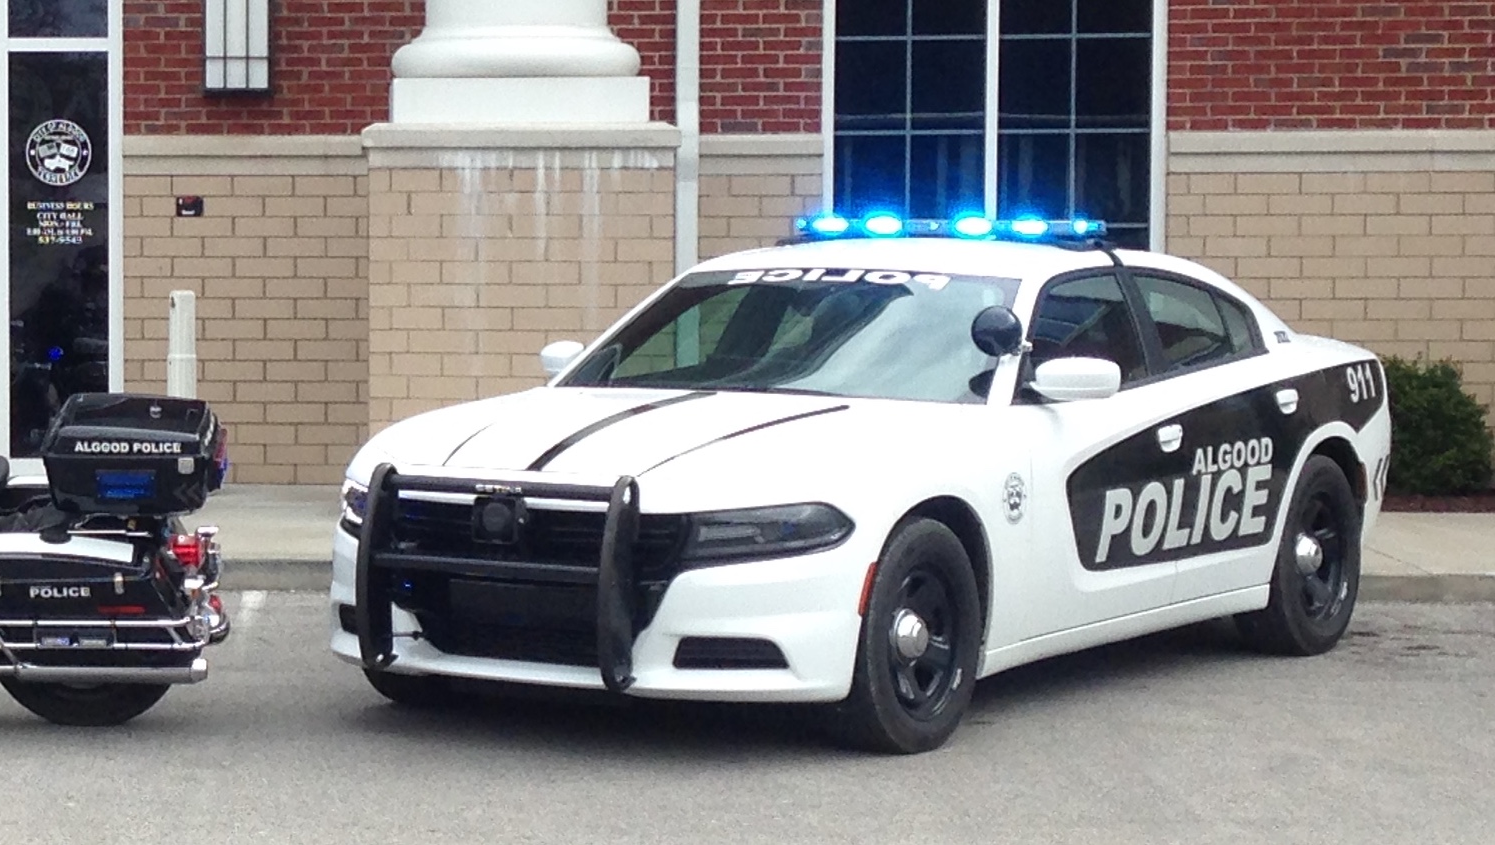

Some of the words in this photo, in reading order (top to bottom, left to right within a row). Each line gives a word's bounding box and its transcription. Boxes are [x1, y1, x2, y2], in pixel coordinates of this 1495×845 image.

[37, 212, 57, 220] CITY
[1346, 362, 1376, 403] 911
[74, 441, 129, 453] ALGOOD
[133, 442, 182, 454] POLICE
[1192, 437, 1273, 475] ALGOOD
[1095, 464, 1272, 563] POLICE
[30, 586, 91, 598] POLICE
